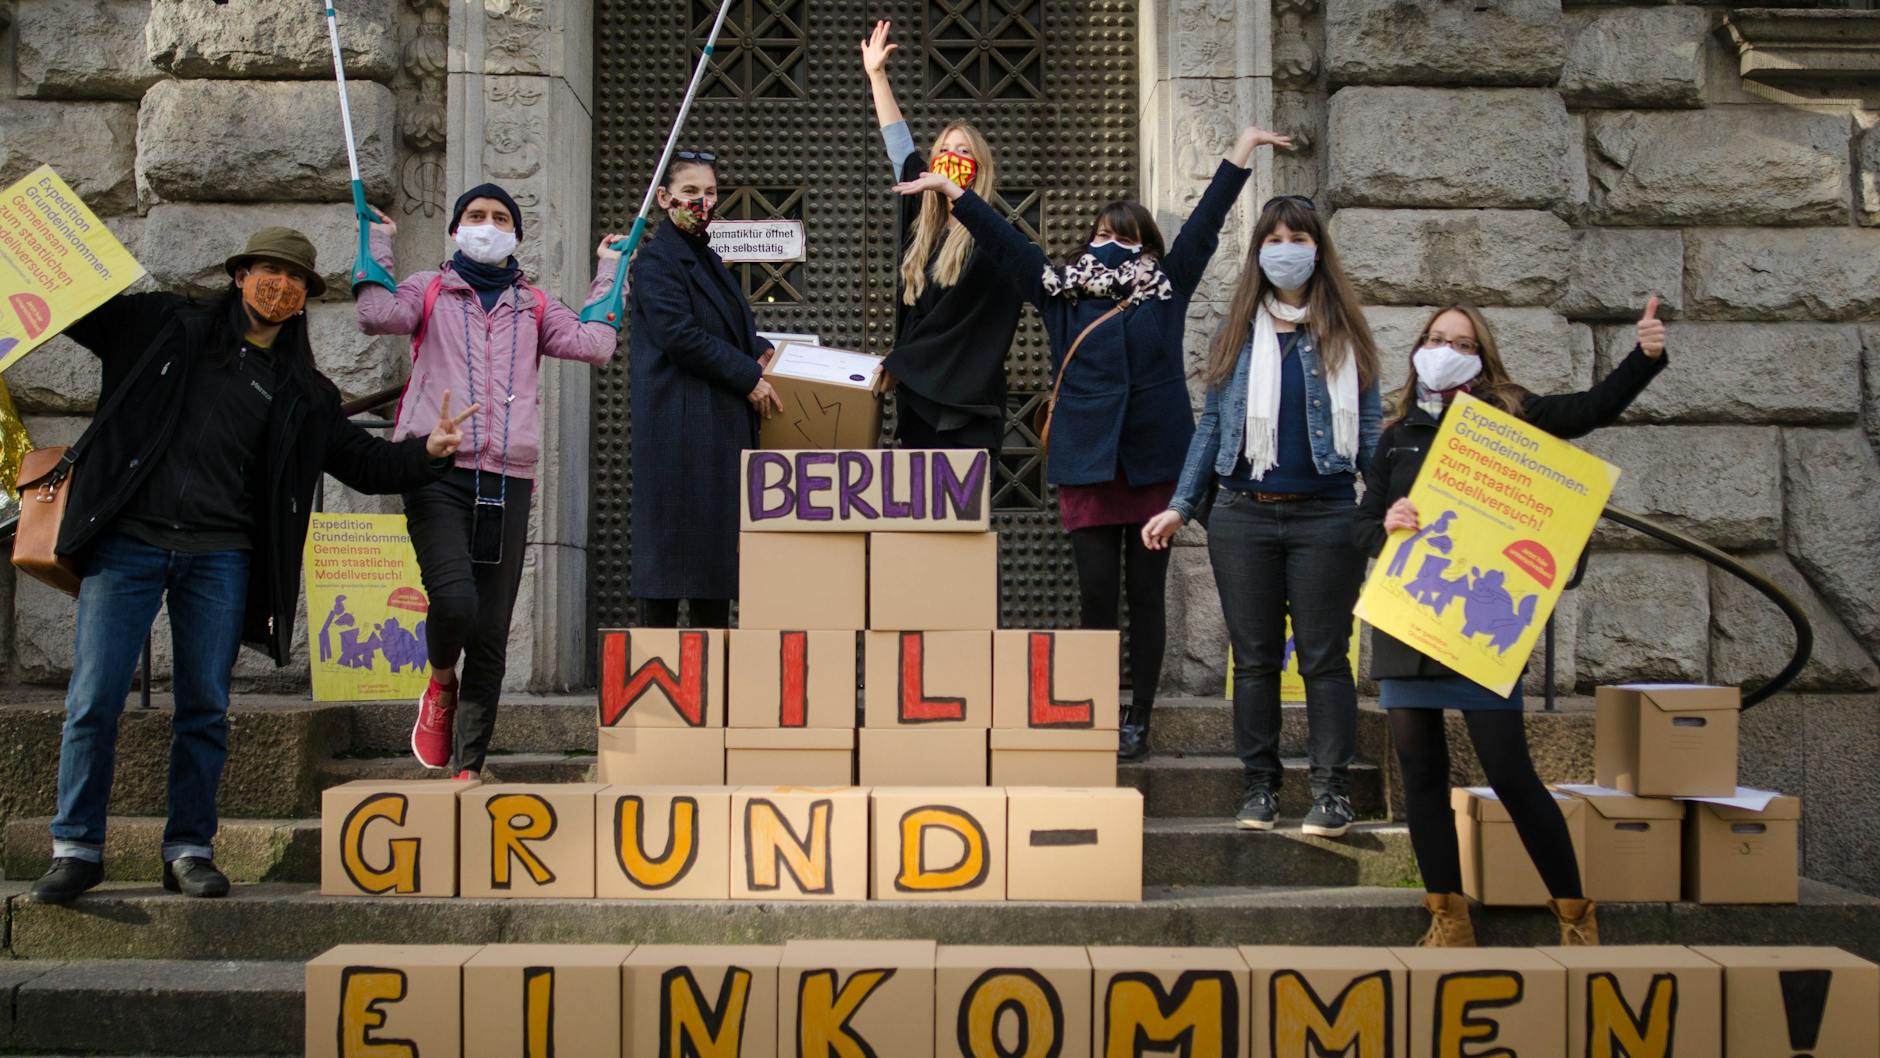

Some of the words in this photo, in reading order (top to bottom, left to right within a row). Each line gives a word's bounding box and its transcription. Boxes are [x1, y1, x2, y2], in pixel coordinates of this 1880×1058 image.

[12, 195, 68, 257] Gemeinsam
[25, 186, 113, 281] Grundeinkommen:
[38, 176, 90, 232] Expedition
[709, 229, 762, 239] tomatiktür
[765, 229, 794, 238] öffnet
[0, 225, 60, 293] dellversuch!
[18, 228, 74, 287] staatlichen
[733, 243, 783, 254] selbsttätig
[1455, 422, 1589, 496] Grundeinkommen:
[1462, 406, 1539, 452] Expedition
[747, 451, 988, 522] BERLIN
[1440, 455, 1471, 477] zum
[1473, 469, 1553, 518] staatlichen
[1448, 438, 1532, 487] Gemeinsam
[312, 519, 373, 531] Expedition
[1433, 467, 1544, 532] Modellversuch!
[314, 544, 381, 554] Gemeinsam
[314, 559, 339, 567] zum
[342, 558, 404, 568] staatlichen
[315, 570, 402, 580] Modellversuch!
[599, 630, 1094, 728] WILL
[339, 792, 1098, 895] GRUND-
[337, 966, 1833, 1058] EINKOMMEN!
